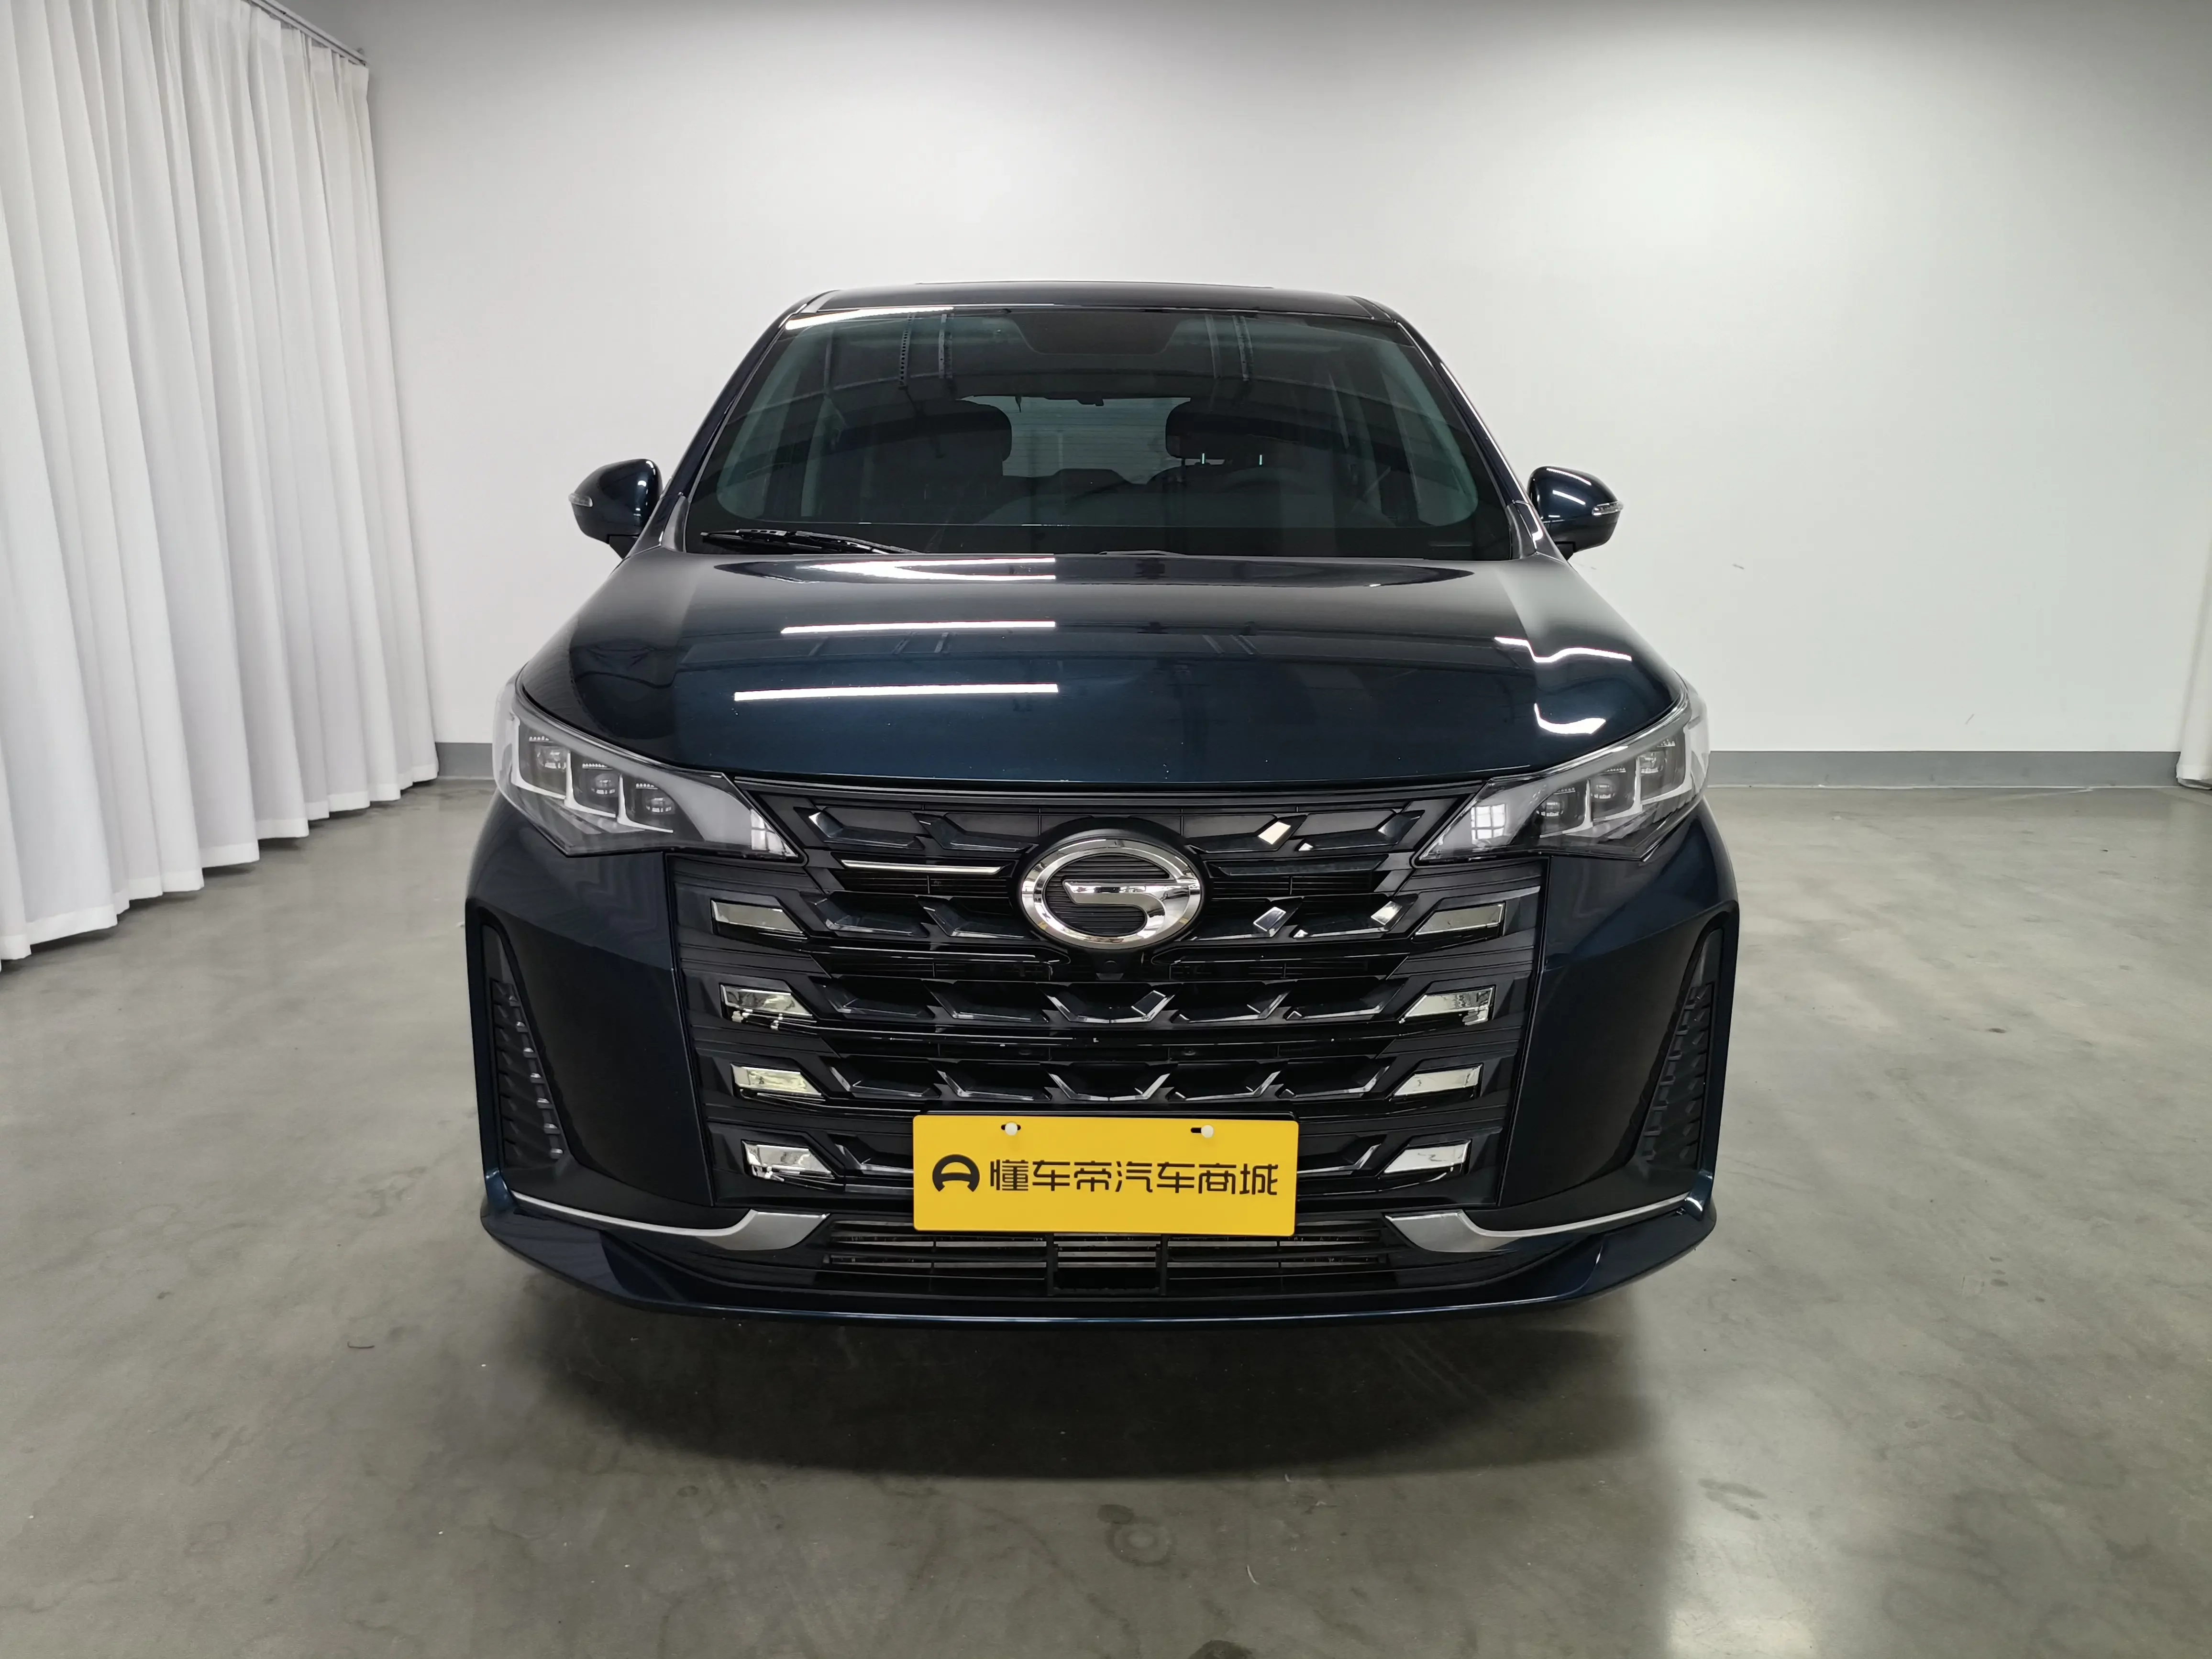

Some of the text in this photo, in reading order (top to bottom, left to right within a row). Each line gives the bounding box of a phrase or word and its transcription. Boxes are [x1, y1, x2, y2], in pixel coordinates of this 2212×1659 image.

[990, 1159, 1278, 1195] 懂车帝汽车商城
